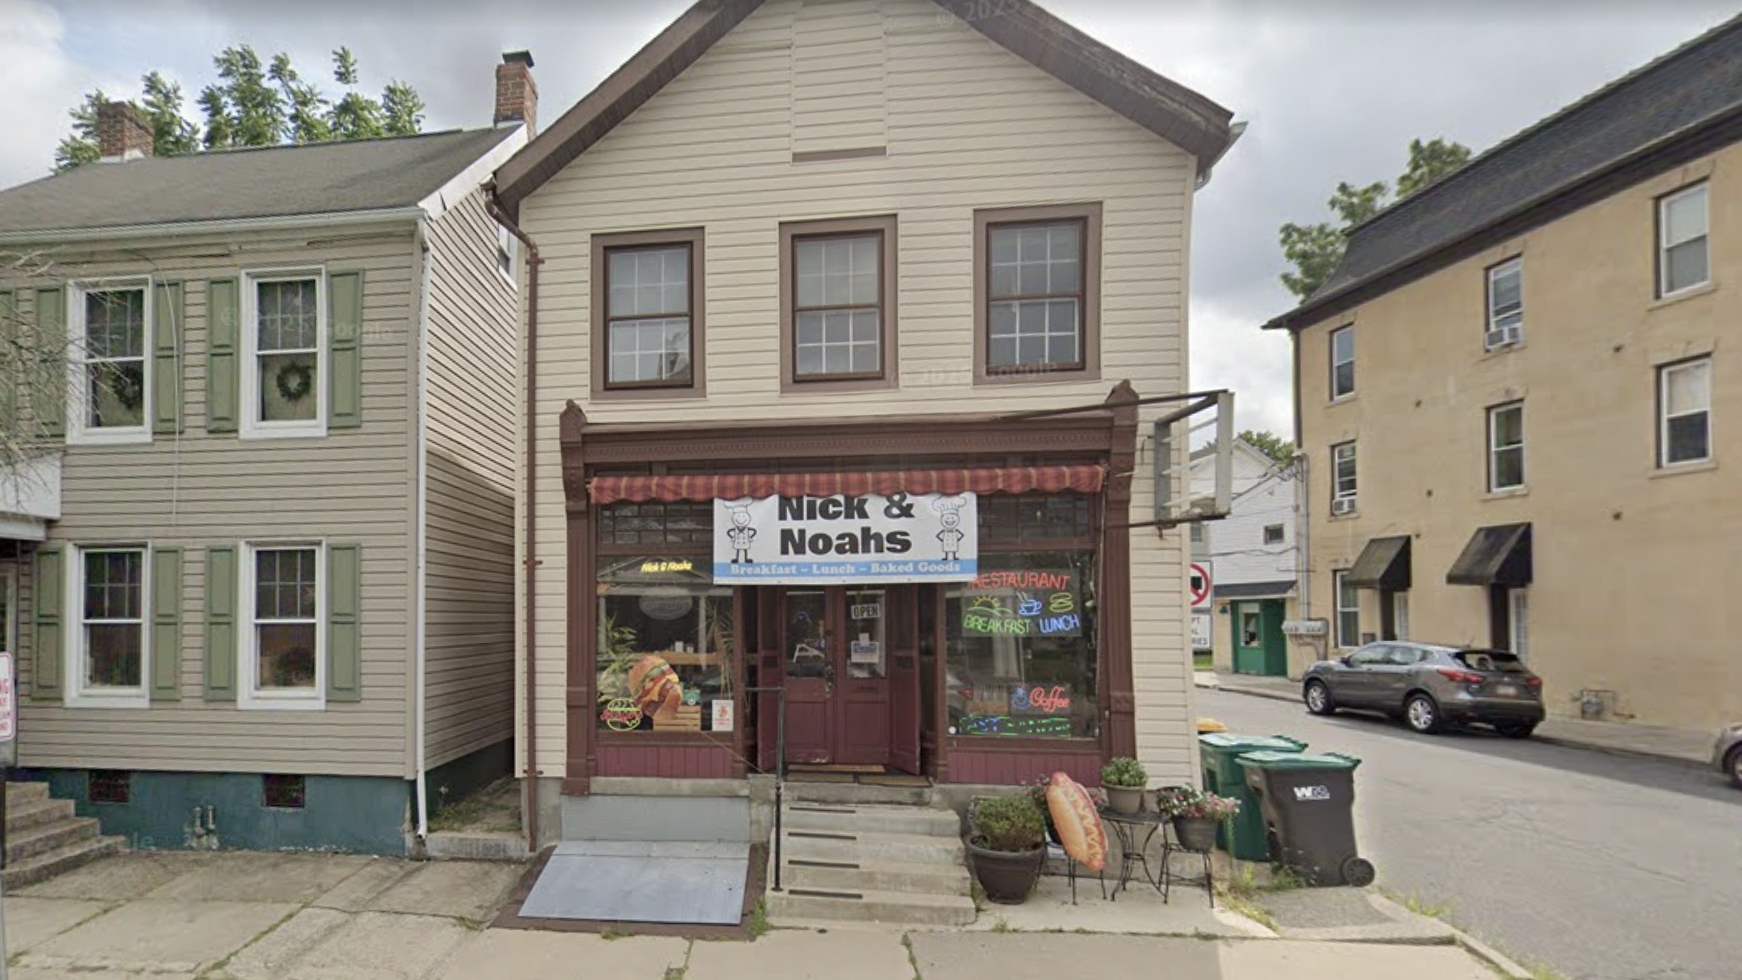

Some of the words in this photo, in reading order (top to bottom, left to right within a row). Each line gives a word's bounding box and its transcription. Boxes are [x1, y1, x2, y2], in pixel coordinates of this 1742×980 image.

[778, 495, 869, 521] Nick
[884, 492, 915, 519] &
[780, 526, 912, 555] Noahs
[730, 562, 797, 576] Breakfast
[812, 561, 855, 574] Lunch
[871, 561, 914, 574] Baked
[918, 560, 961, 572] Goods
[968, 571, 1071, 590] RESTAURANT
[853, 604, 878, 617] OPEN
[963, 614, 1031, 634] BREAKFAST
[1039, 613, 1079, 633] LUNCH
[1029, 686, 1070, 713] Coffee
